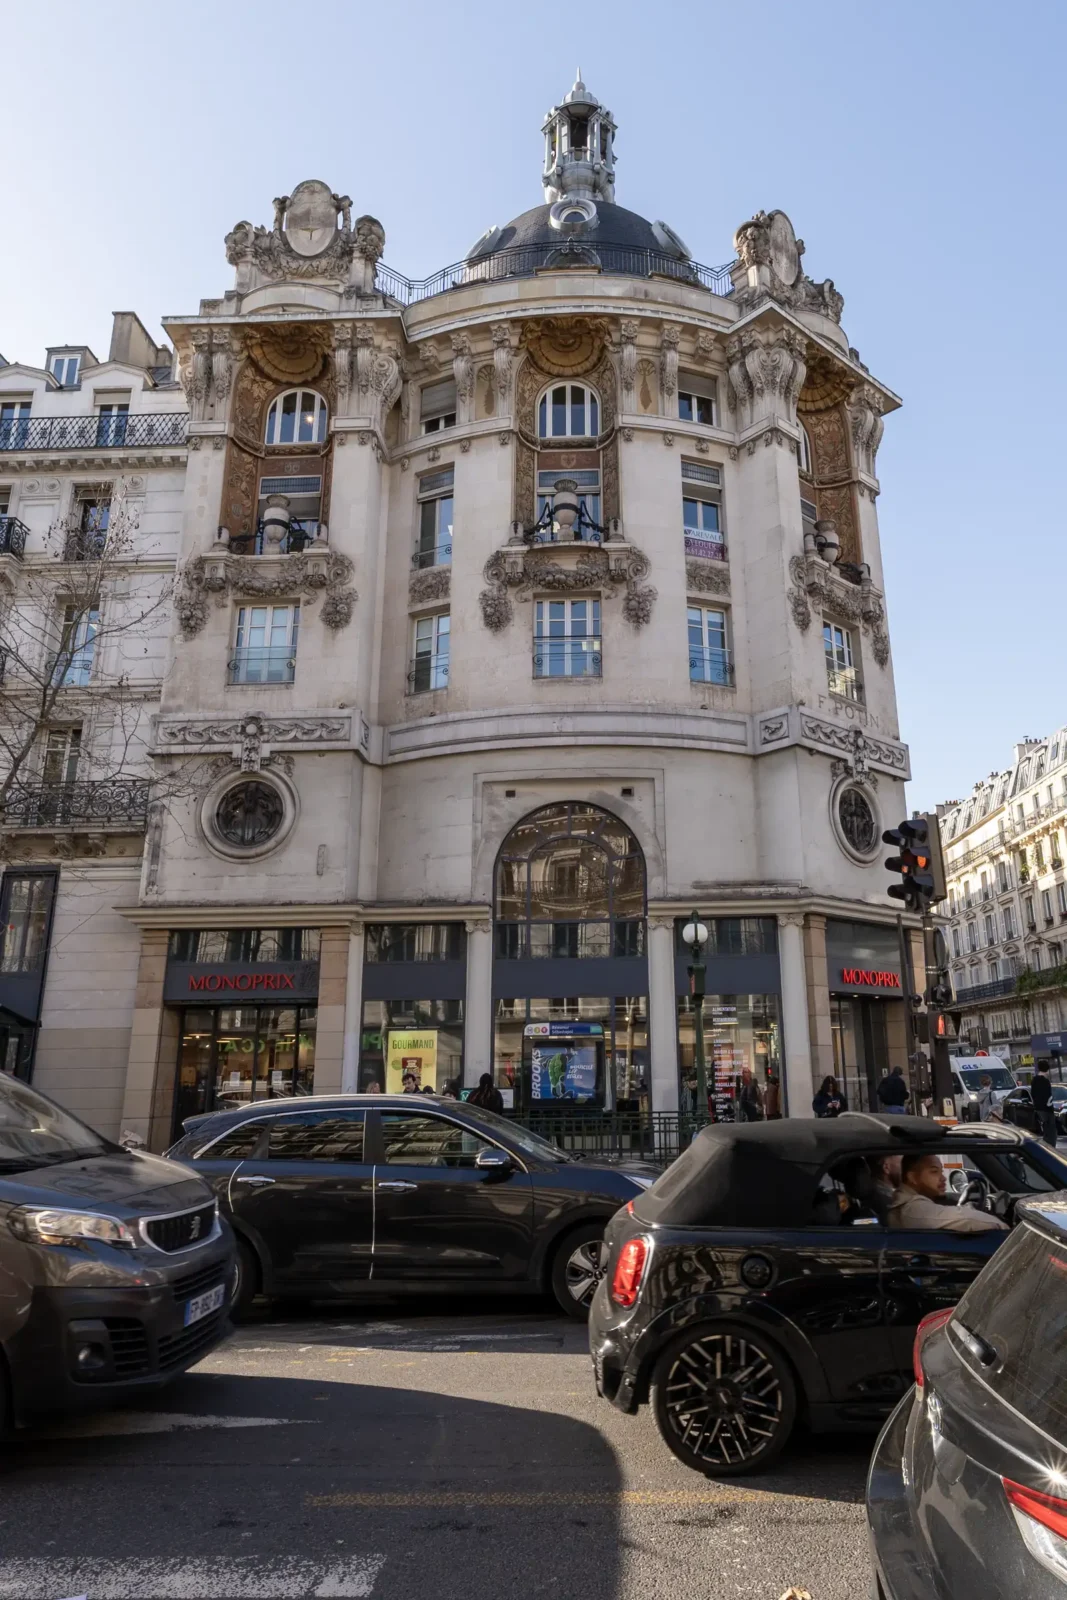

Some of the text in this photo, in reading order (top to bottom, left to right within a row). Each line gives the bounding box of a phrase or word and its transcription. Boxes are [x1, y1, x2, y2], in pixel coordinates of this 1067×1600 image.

[188, 973, 295, 991] MONOPRIX
[843, 967, 901, 988] MONOPRIX
[392, 1039, 434, 1050] GOURMAND
[531, 1048, 541, 1099] BROOKS
